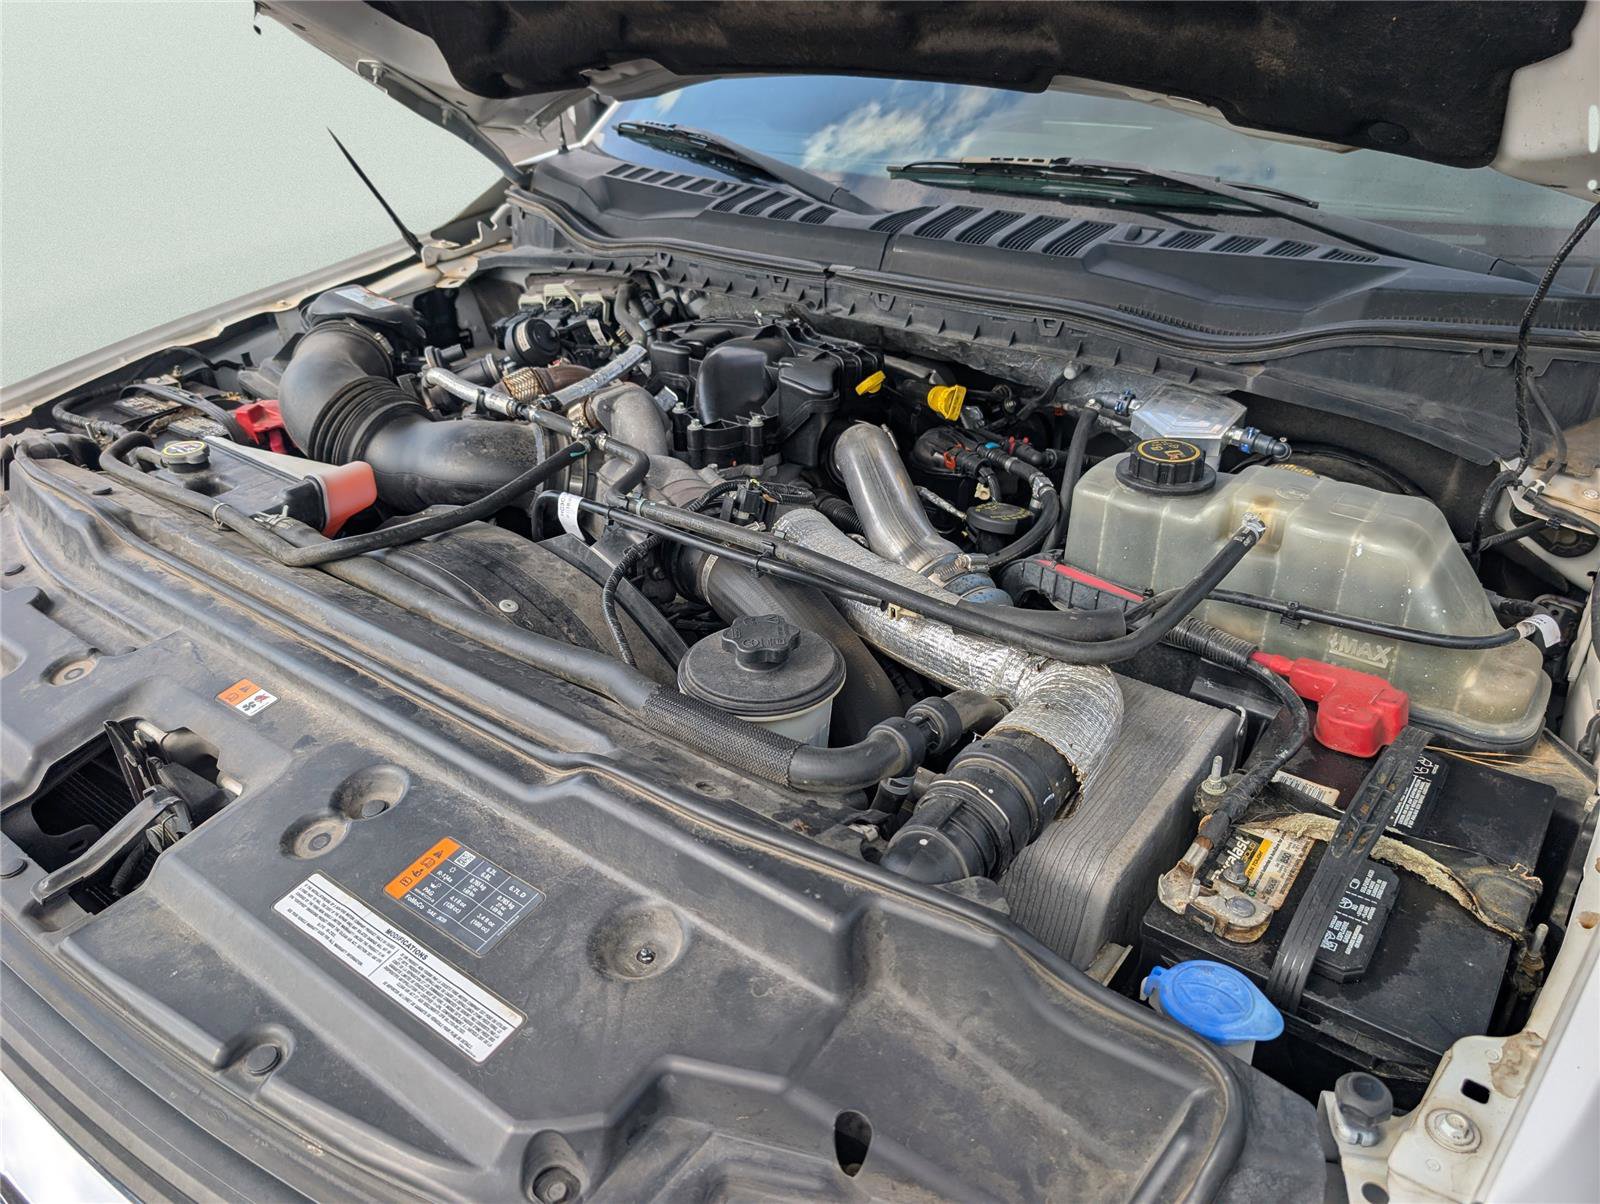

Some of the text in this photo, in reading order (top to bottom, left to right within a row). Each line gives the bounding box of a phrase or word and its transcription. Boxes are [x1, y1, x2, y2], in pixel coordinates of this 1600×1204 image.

[1339, 635, 1394, 665] MAX
[508, 885, 521, 896] 6.7L
[385, 928, 429, 961] MODIFICATIONS
